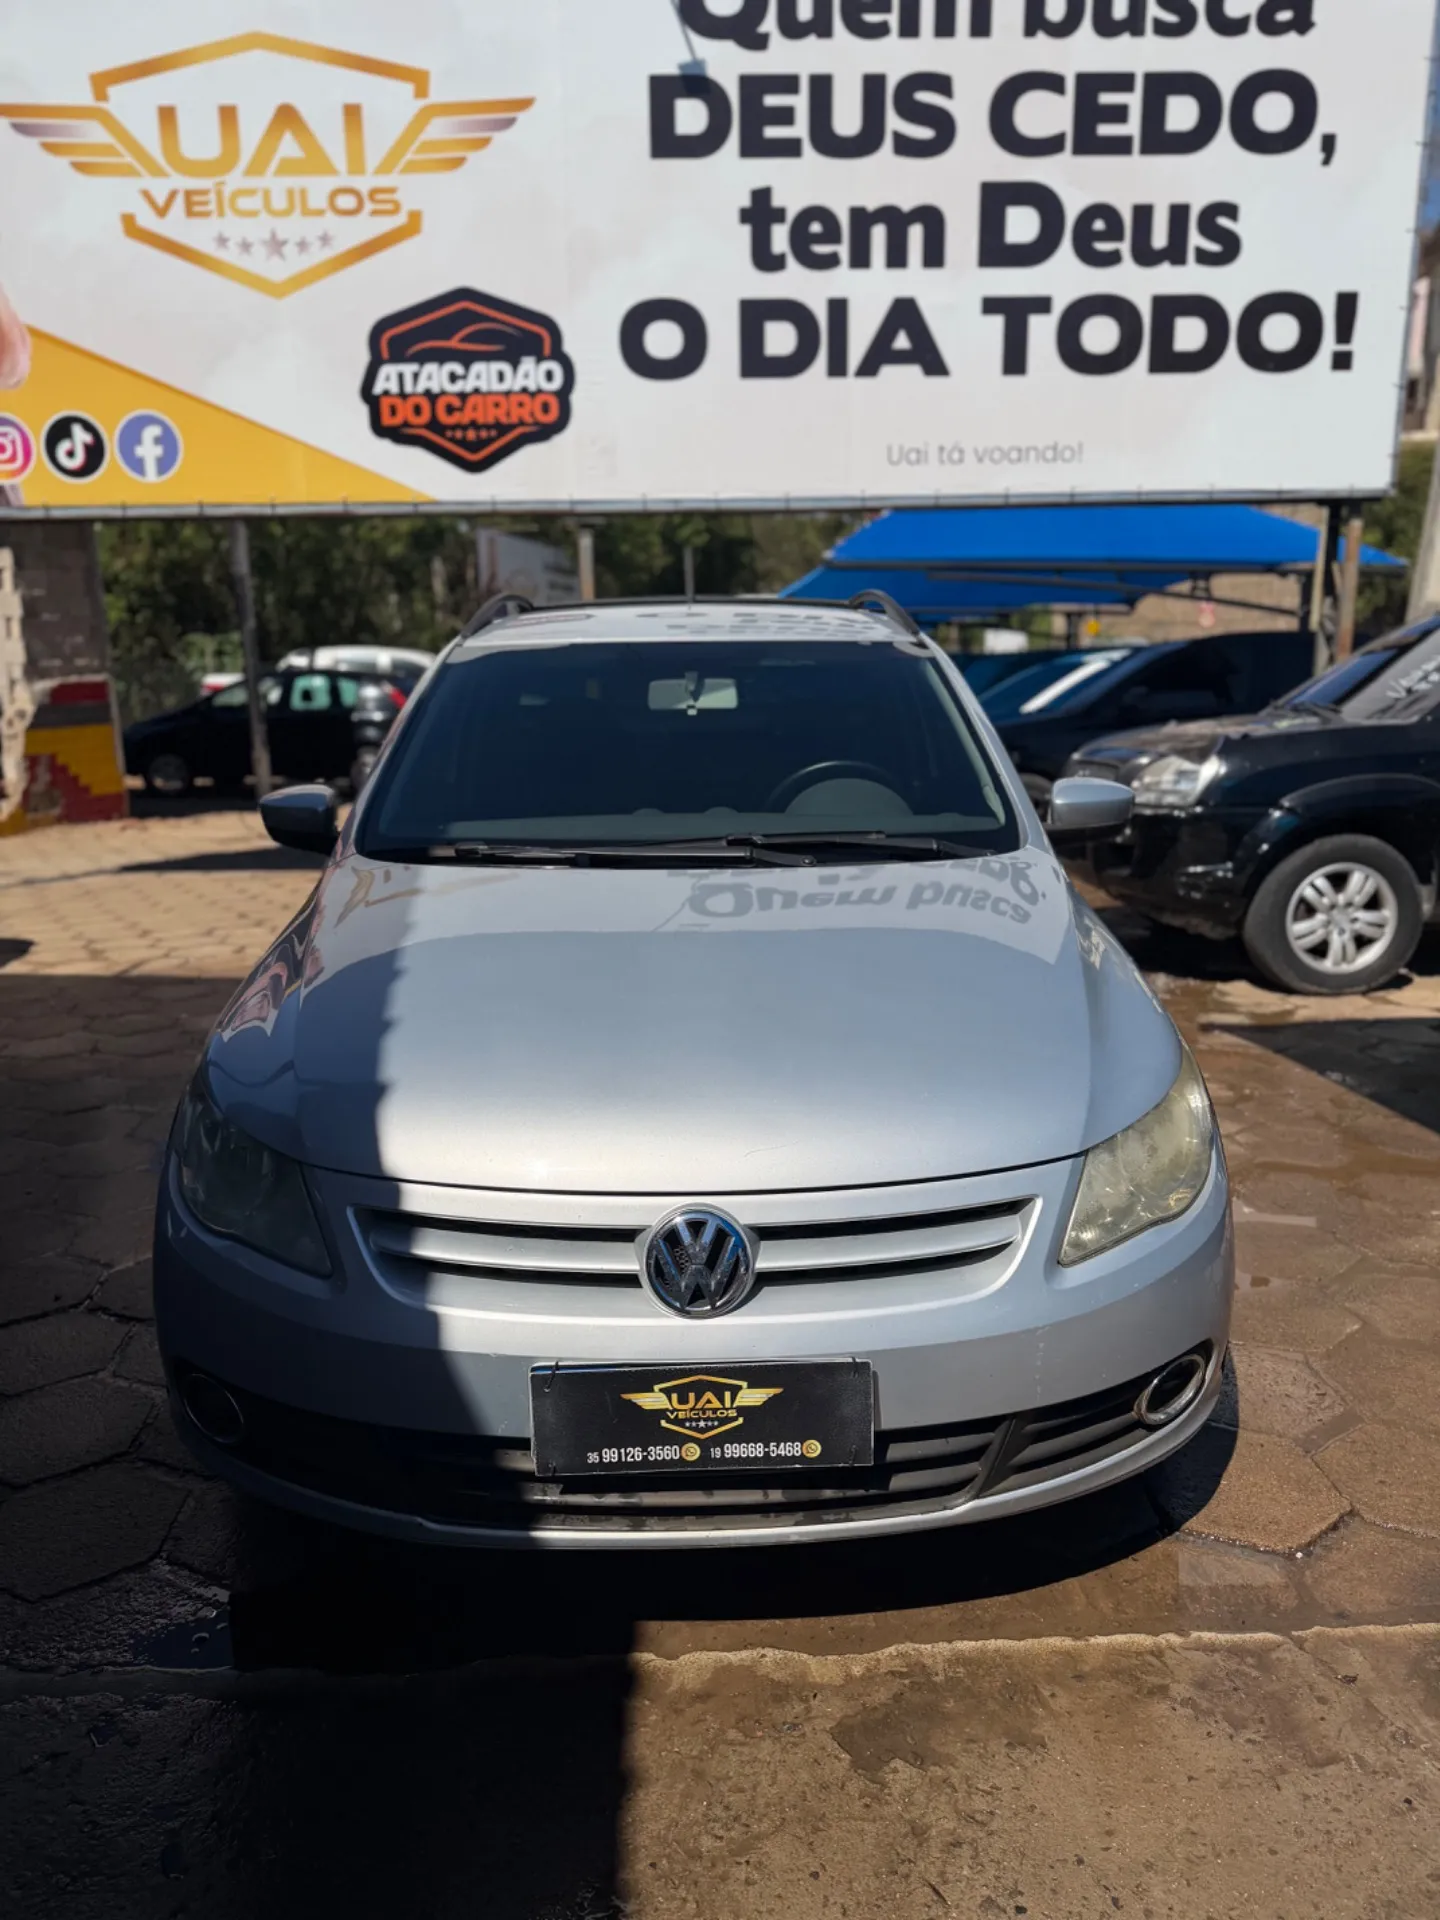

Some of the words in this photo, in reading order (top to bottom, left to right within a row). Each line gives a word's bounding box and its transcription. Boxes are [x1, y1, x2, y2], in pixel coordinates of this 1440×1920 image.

[649, 71, 956, 160] DEUS
[989, 69, 1336, 166] CEDO,
[157, 103, 366, 178] UAI
[140, 181, 402, 219] VEÍCULOS
[739, 187, 946, 273] tem
[978, 181, 1242, 268] Deus
[619, 298, 707, 380] O
[739, 297, 950, 379] DIA
[981, 292, 1359, 376] TODO!
[371, 355, 564, 395] ATACADÃO
[379, 395, 432, 427] DO
[435, 393, 560, 425] CARRO
[886, 442, 930, 467] Uai
[937, 441, 966, 466] tá
[973, 440, 1084, 466] voando!
[666, 1408, 738, 1420] VEÍCULOS
[671, 1391, 732, 1409] UAI
[587, 1452, 600, 1464] 35
[602, 1444, 680, 1464] 99126-3560
[710, 1447, 722, 1459] 19
[723, 1441, 802, 1459] 99668-5468
